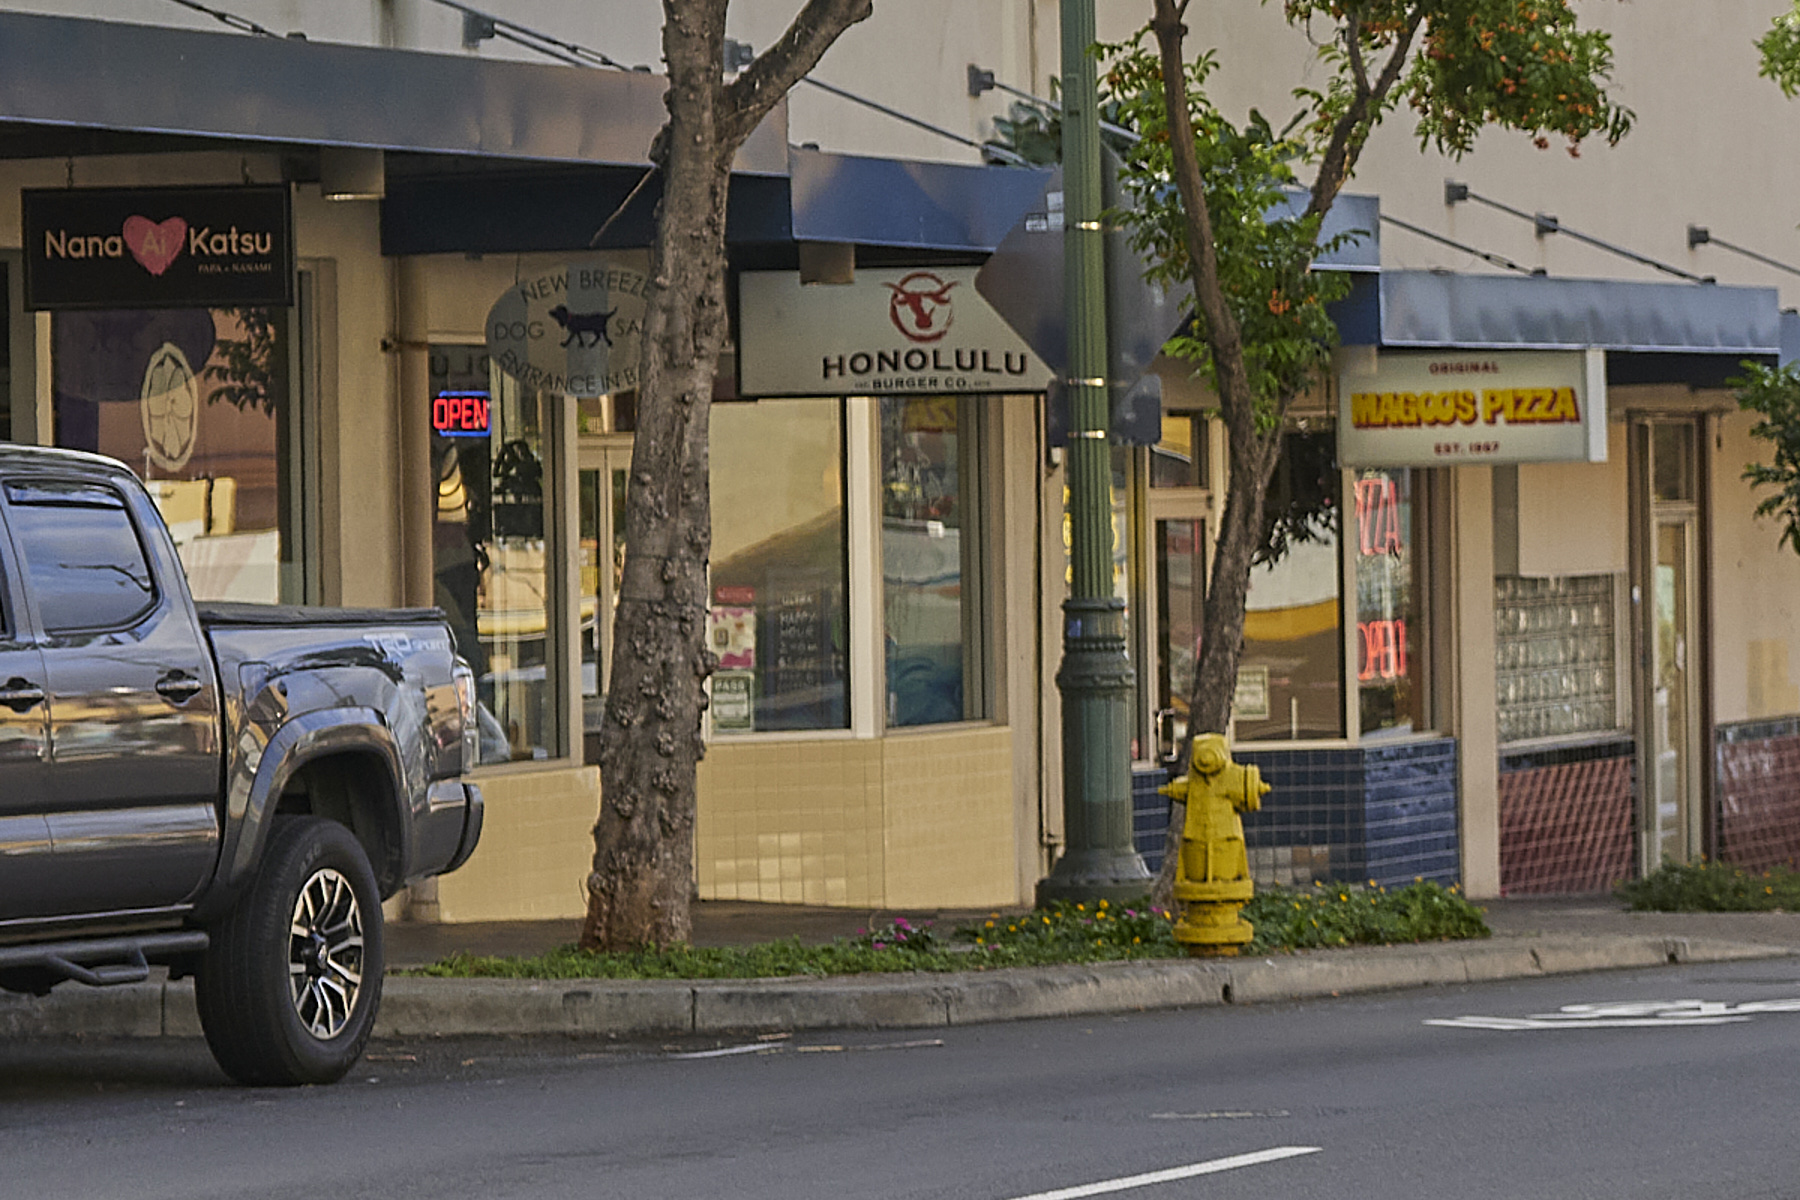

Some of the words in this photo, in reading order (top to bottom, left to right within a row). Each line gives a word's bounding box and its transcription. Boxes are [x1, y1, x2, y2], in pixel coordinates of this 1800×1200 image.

[45, 229, 123, 259] Nana
[141, 228, 167, 256] Ai
[189, 225, 272, 256] Katsu
[519, 271, 571, 303] NEW
[494, 321, 545, 341] DOG
[499, 348, 597, 394] ENTRANCE
[601, 372, 620, 390] IN
[822, 348, 1028, 380] HONOLULU
[1428, 361, 1500, 375] ORIGINAL
[872, 377, 938, 390] BURGER
[433, 398, 487, 430] OPEN
[1351, 389, 1479, 429] MAGOO'S
[1481, 386, 1581, 426] PIZZA
